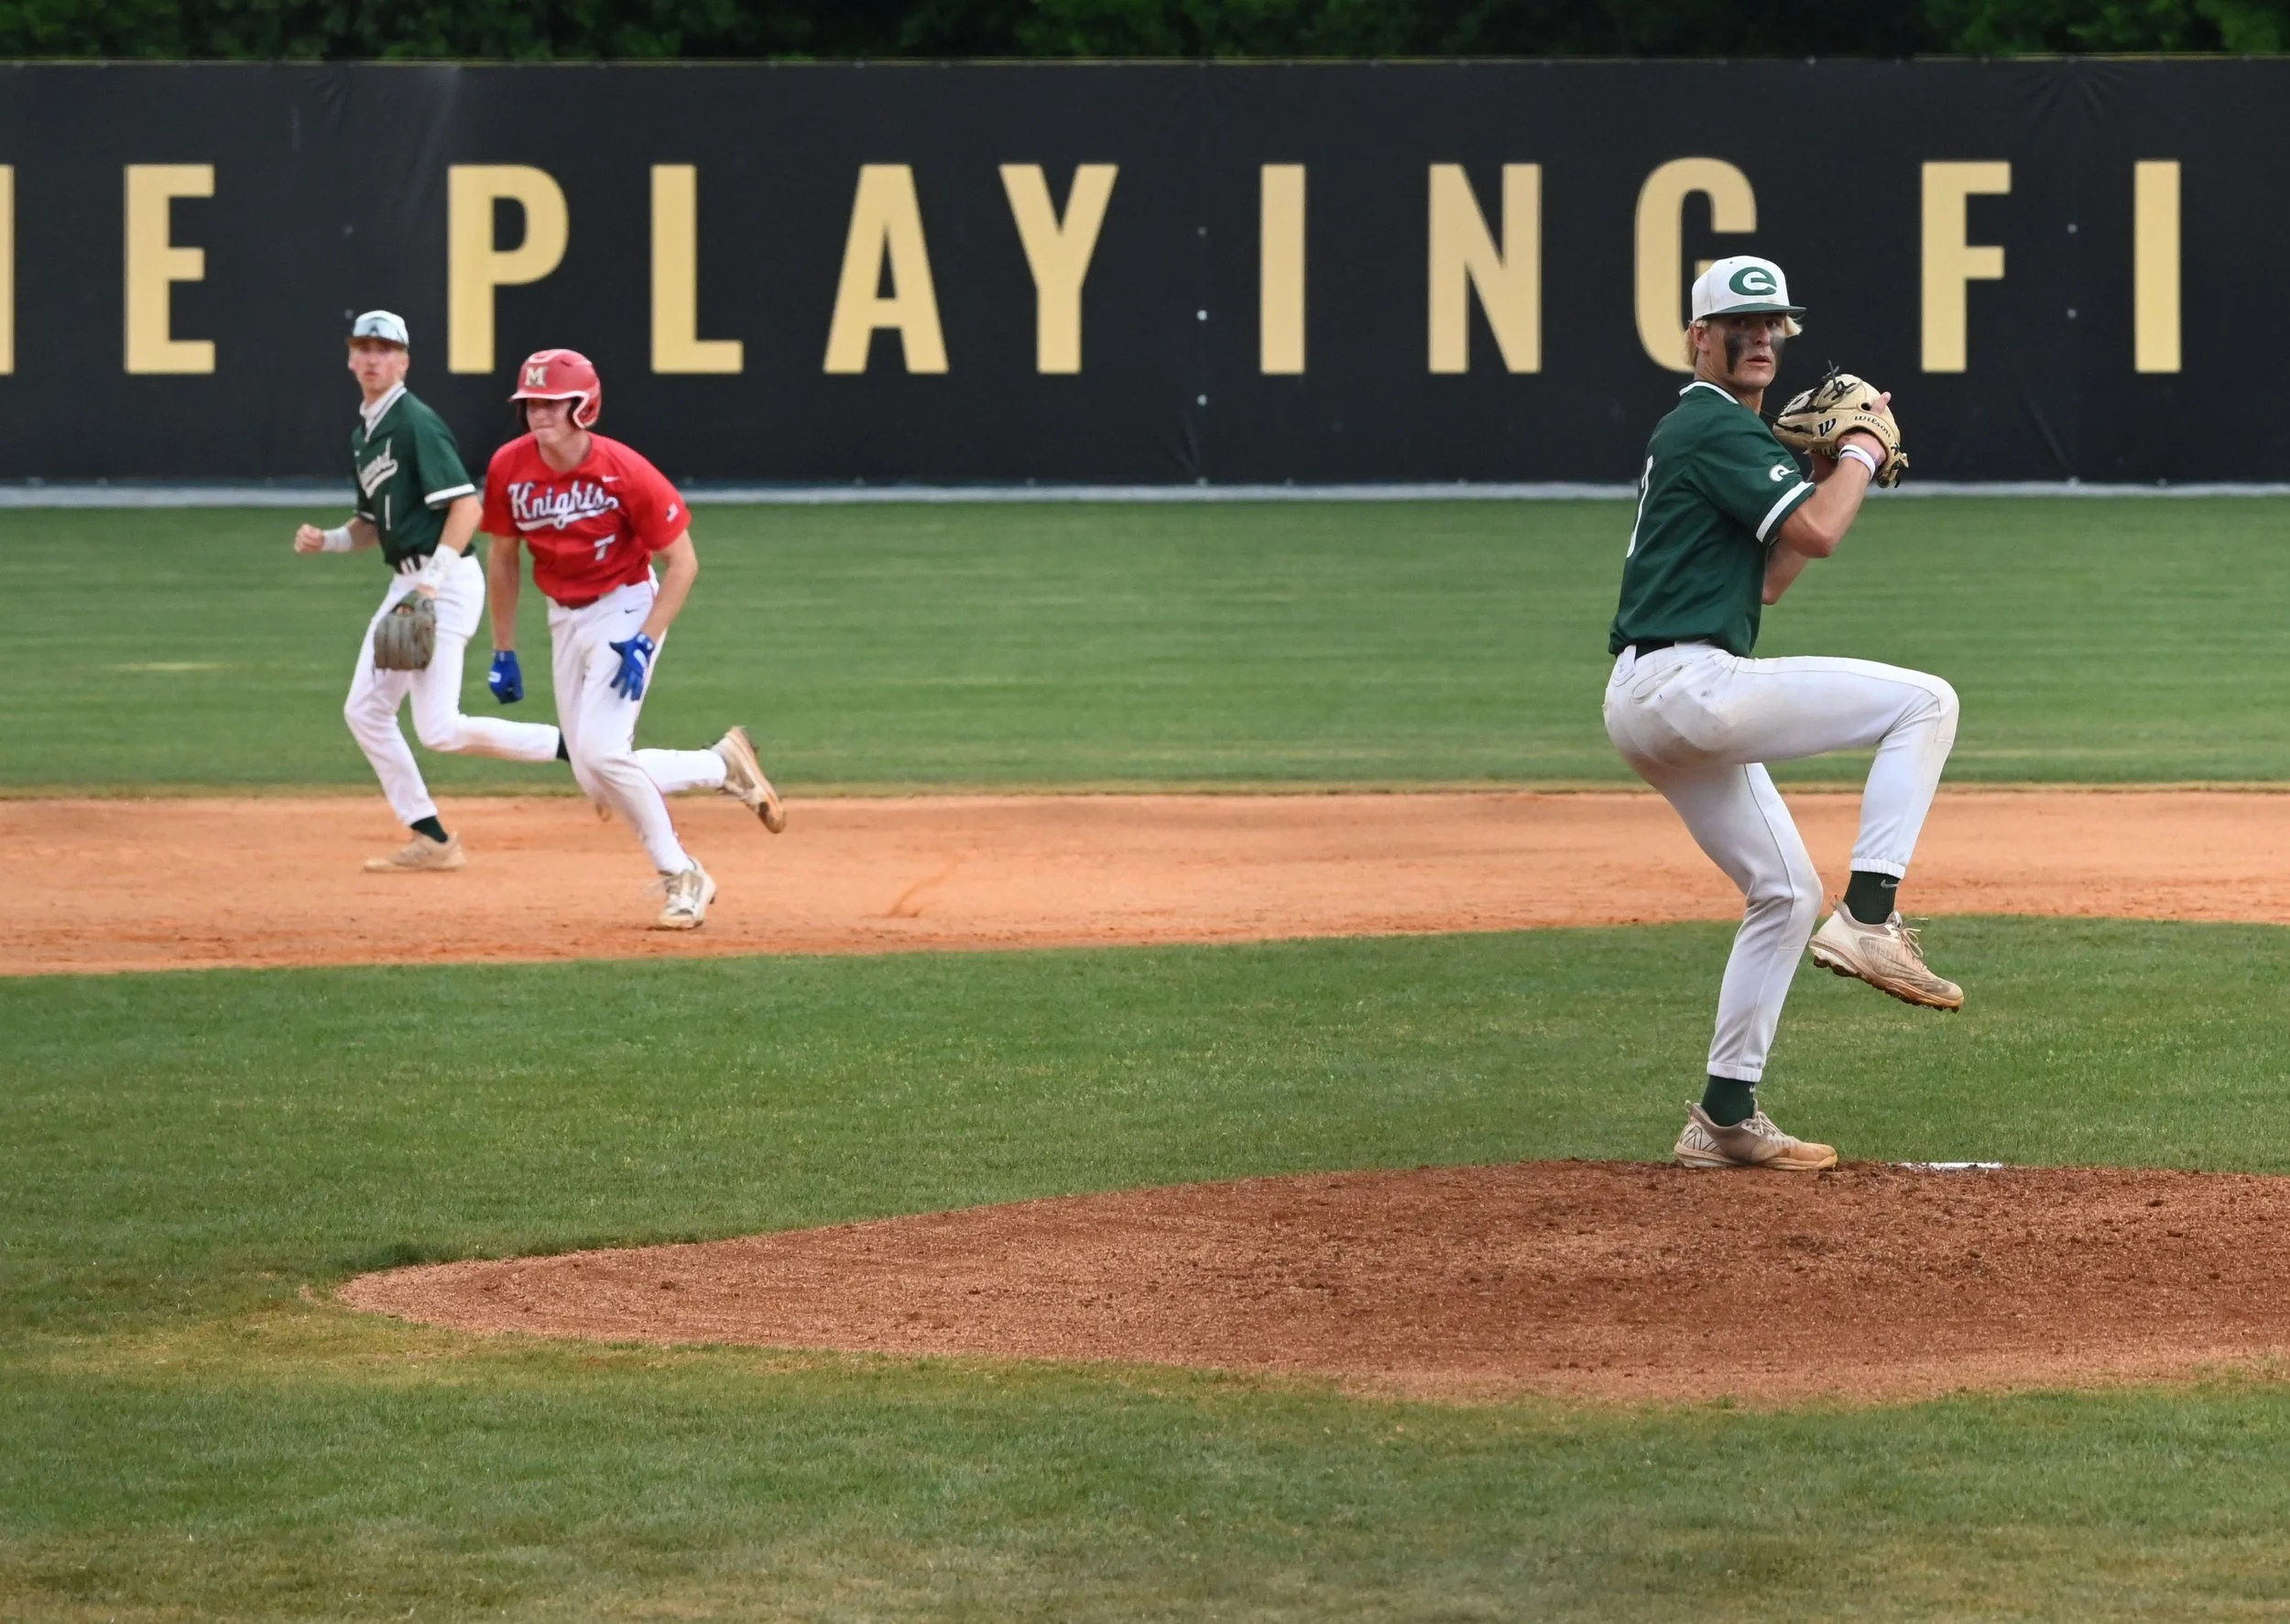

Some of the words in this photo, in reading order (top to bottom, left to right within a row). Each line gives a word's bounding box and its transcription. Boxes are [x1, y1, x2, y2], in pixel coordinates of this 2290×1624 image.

[0, 164, 216, 374] E
[448, 158, 1756, 374] PLAYING
[1921, 160, 2182, 373] FI
[525, 365, 549, 388] M
[507, 480, 620, 531] Knights
[593, 533, 616, 561] 7
